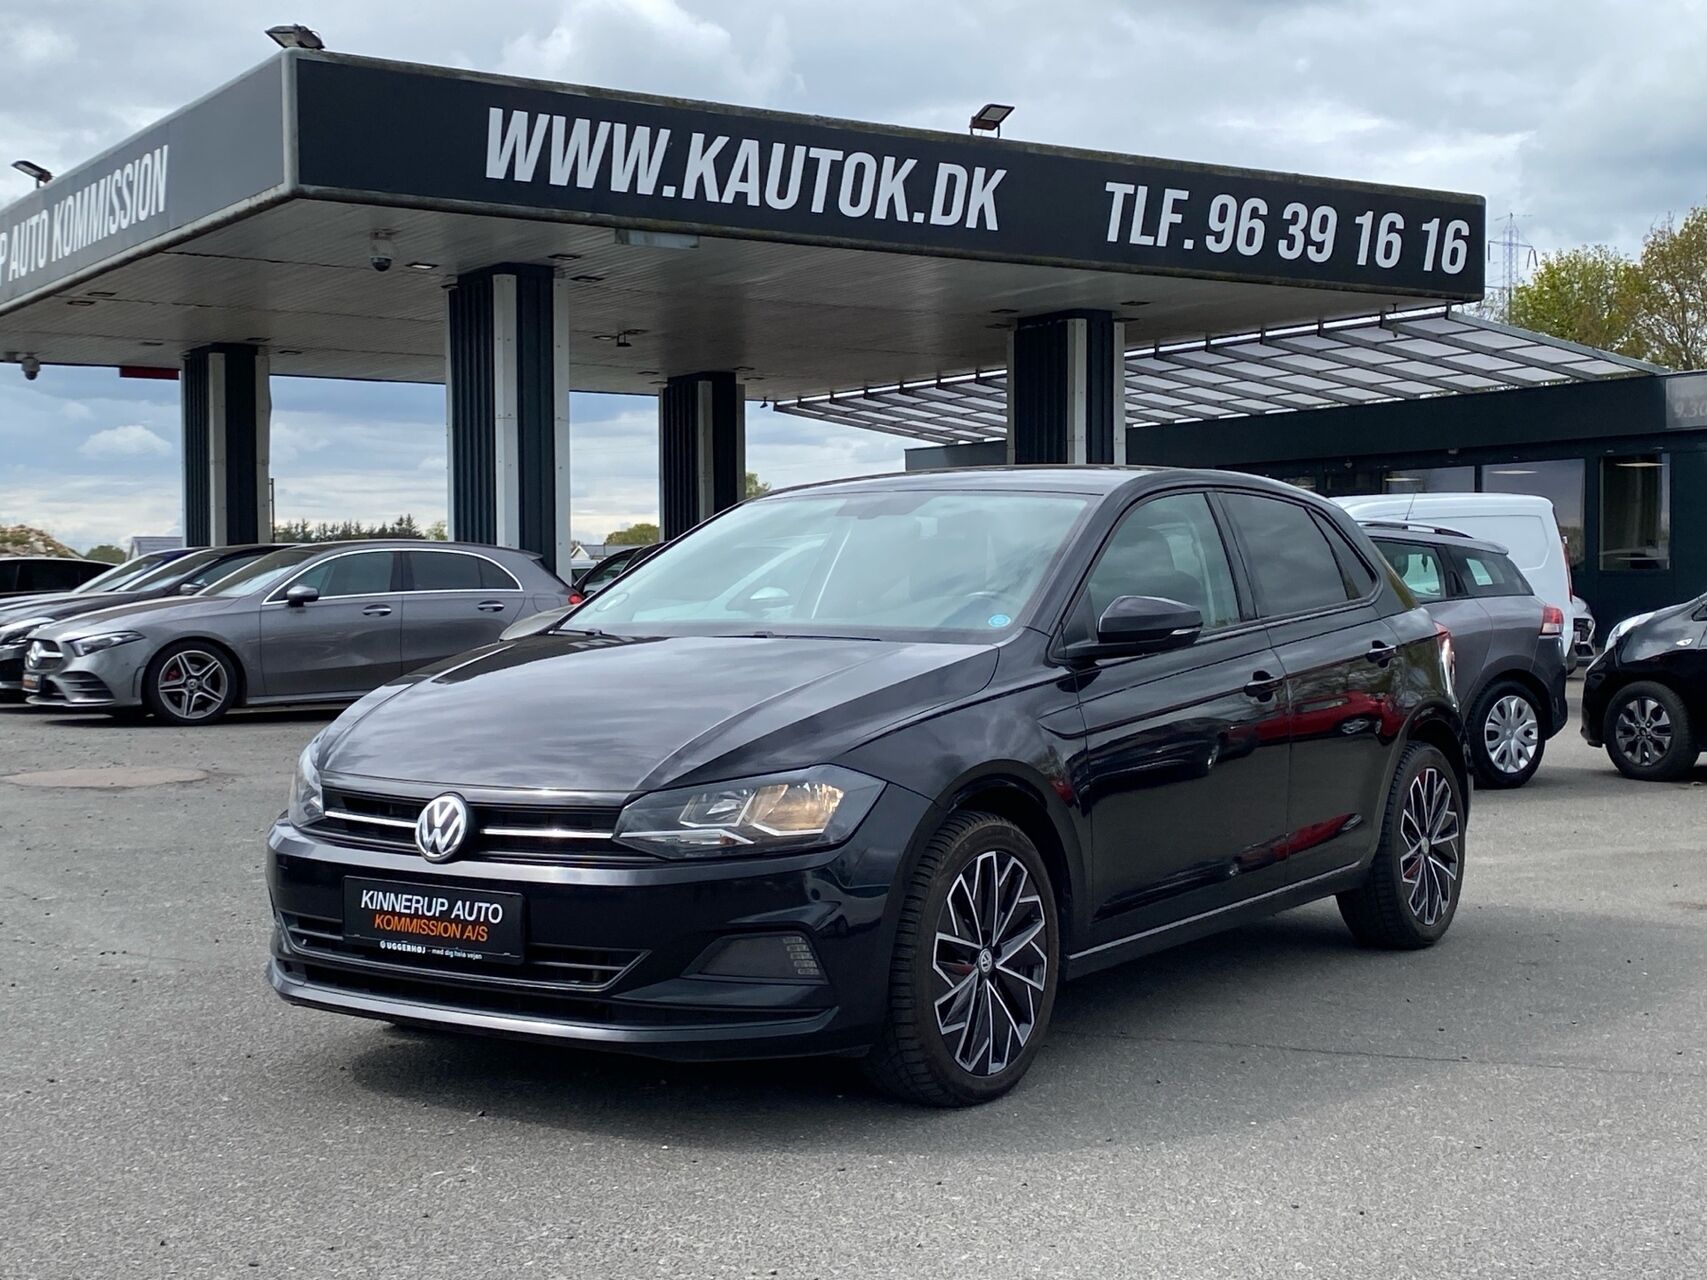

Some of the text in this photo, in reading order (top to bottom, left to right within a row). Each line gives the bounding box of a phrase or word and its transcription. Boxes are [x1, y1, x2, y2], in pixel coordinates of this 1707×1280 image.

[8, 209, 49, 282] AUTO
[52, 144, 169, 262] KOMMISSION
[485, 106, 1007, 231] WWW.KAUTOK.DK
[1105, 181, 1470, 275] TLF. 96 39 16 16
[361, 889, 503, 924] KINNERUP AUTO
[374, 914, 488, 942] KOMMISSION A/S
